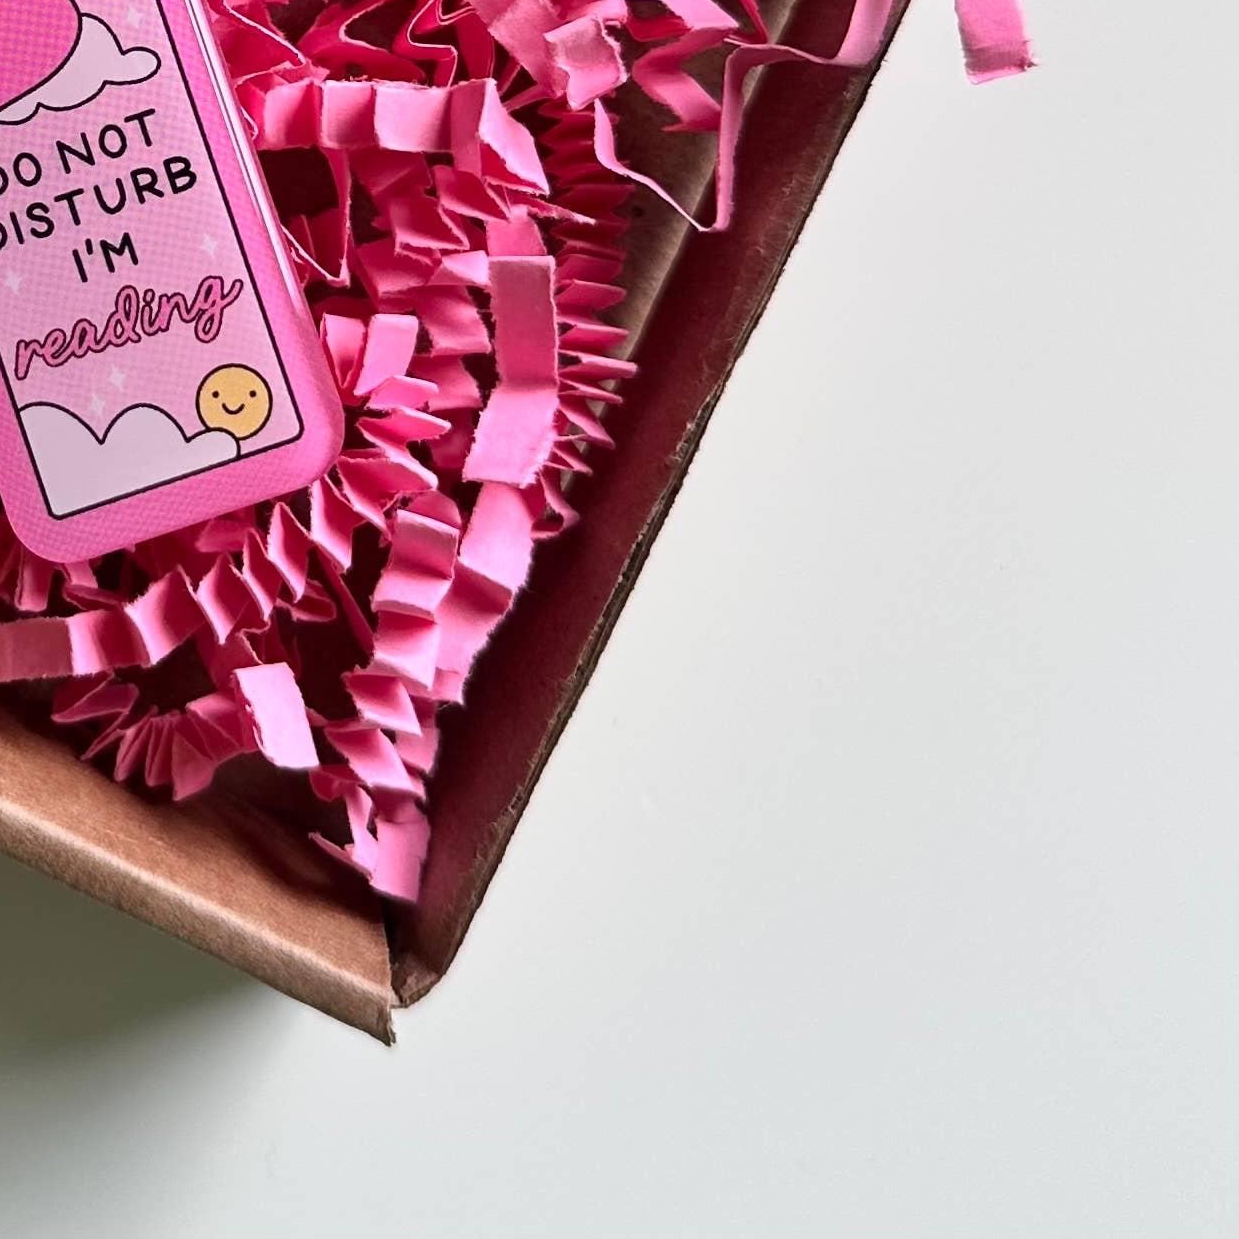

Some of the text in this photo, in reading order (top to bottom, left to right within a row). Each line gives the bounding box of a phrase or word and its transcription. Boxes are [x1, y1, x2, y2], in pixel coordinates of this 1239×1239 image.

[56, 108, 156, 174] NOT
[72, 232, 139, 283] I'M
[14, 275, 244, 380] reading
